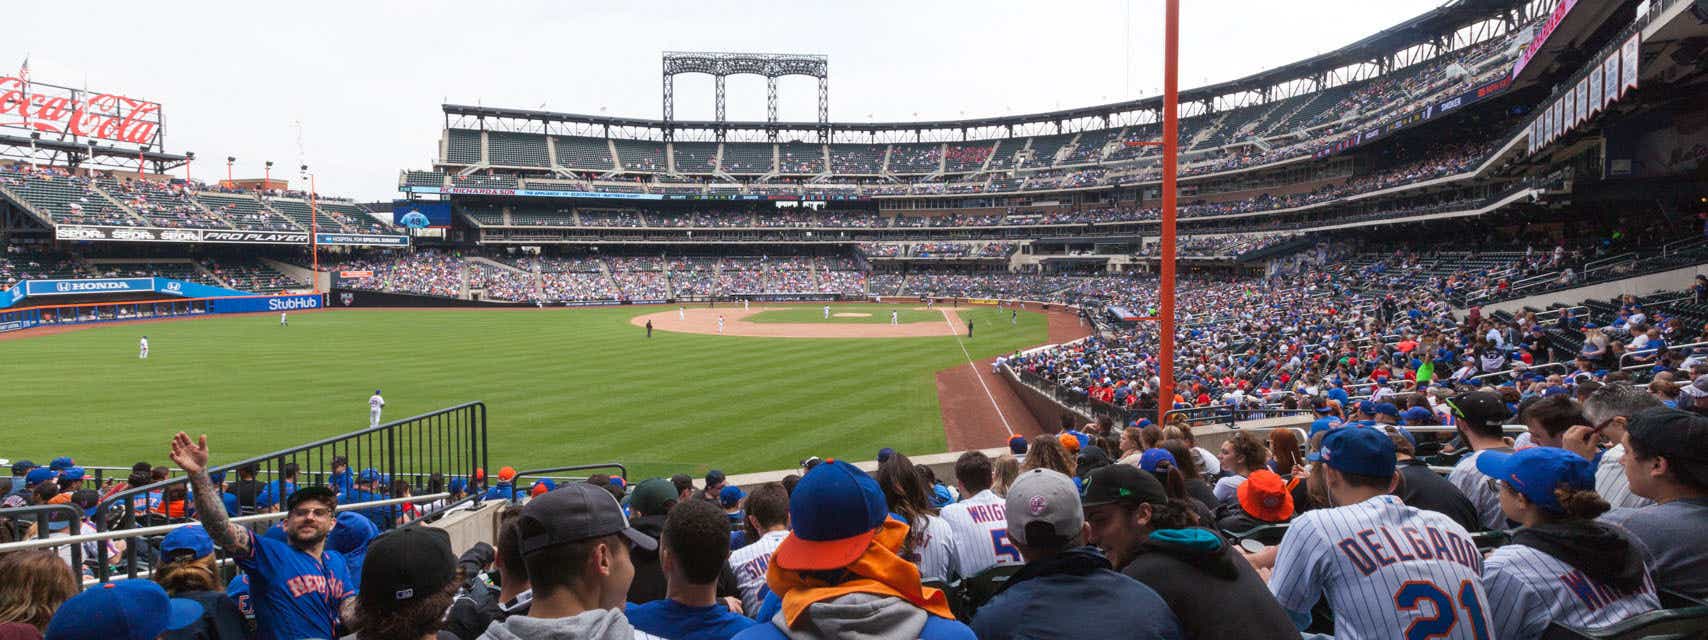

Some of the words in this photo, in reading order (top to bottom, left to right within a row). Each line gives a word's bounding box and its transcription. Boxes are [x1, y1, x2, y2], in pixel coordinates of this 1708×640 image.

[204, 232, 244, 240] PRO
[244, 233, 307, 242] PLAYER
[72, 282, 130, 290] HONDA
[268, 297, 317, 311] StubHub
[1338, 526, 1482, 577] DELGADO
[287, 573, 328, 598] NEW
[1394, 579, 1491, 640] 21
